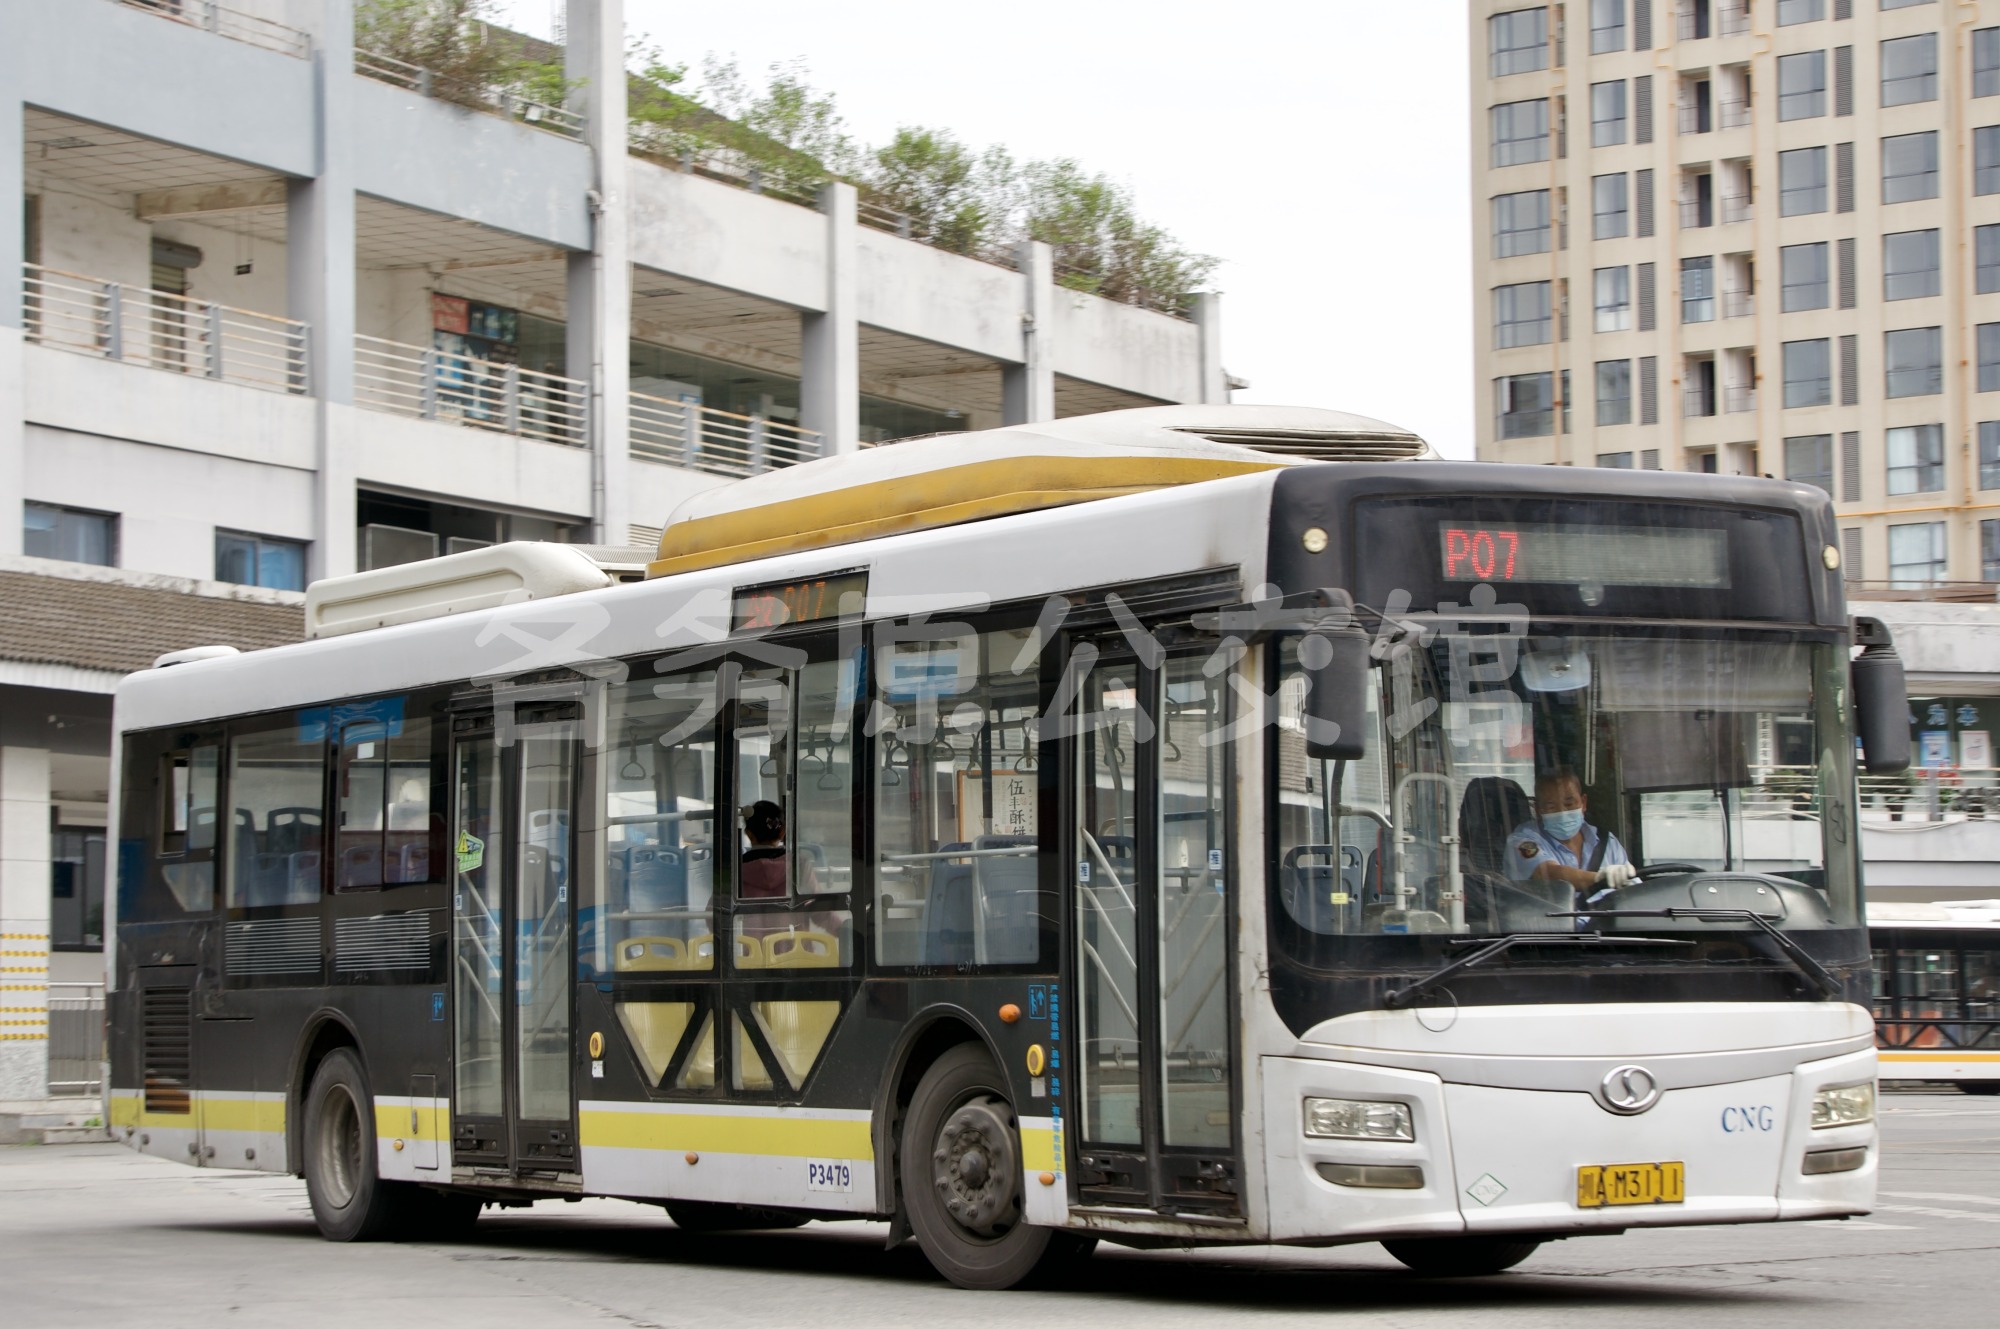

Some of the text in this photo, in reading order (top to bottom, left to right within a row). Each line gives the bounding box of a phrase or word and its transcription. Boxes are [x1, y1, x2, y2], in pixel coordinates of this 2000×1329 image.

[1447, 529, 1519, 580] P07
[1721, 1105, 1774, 1133] CNG
[809, 1163, 850, 1187] P3479
